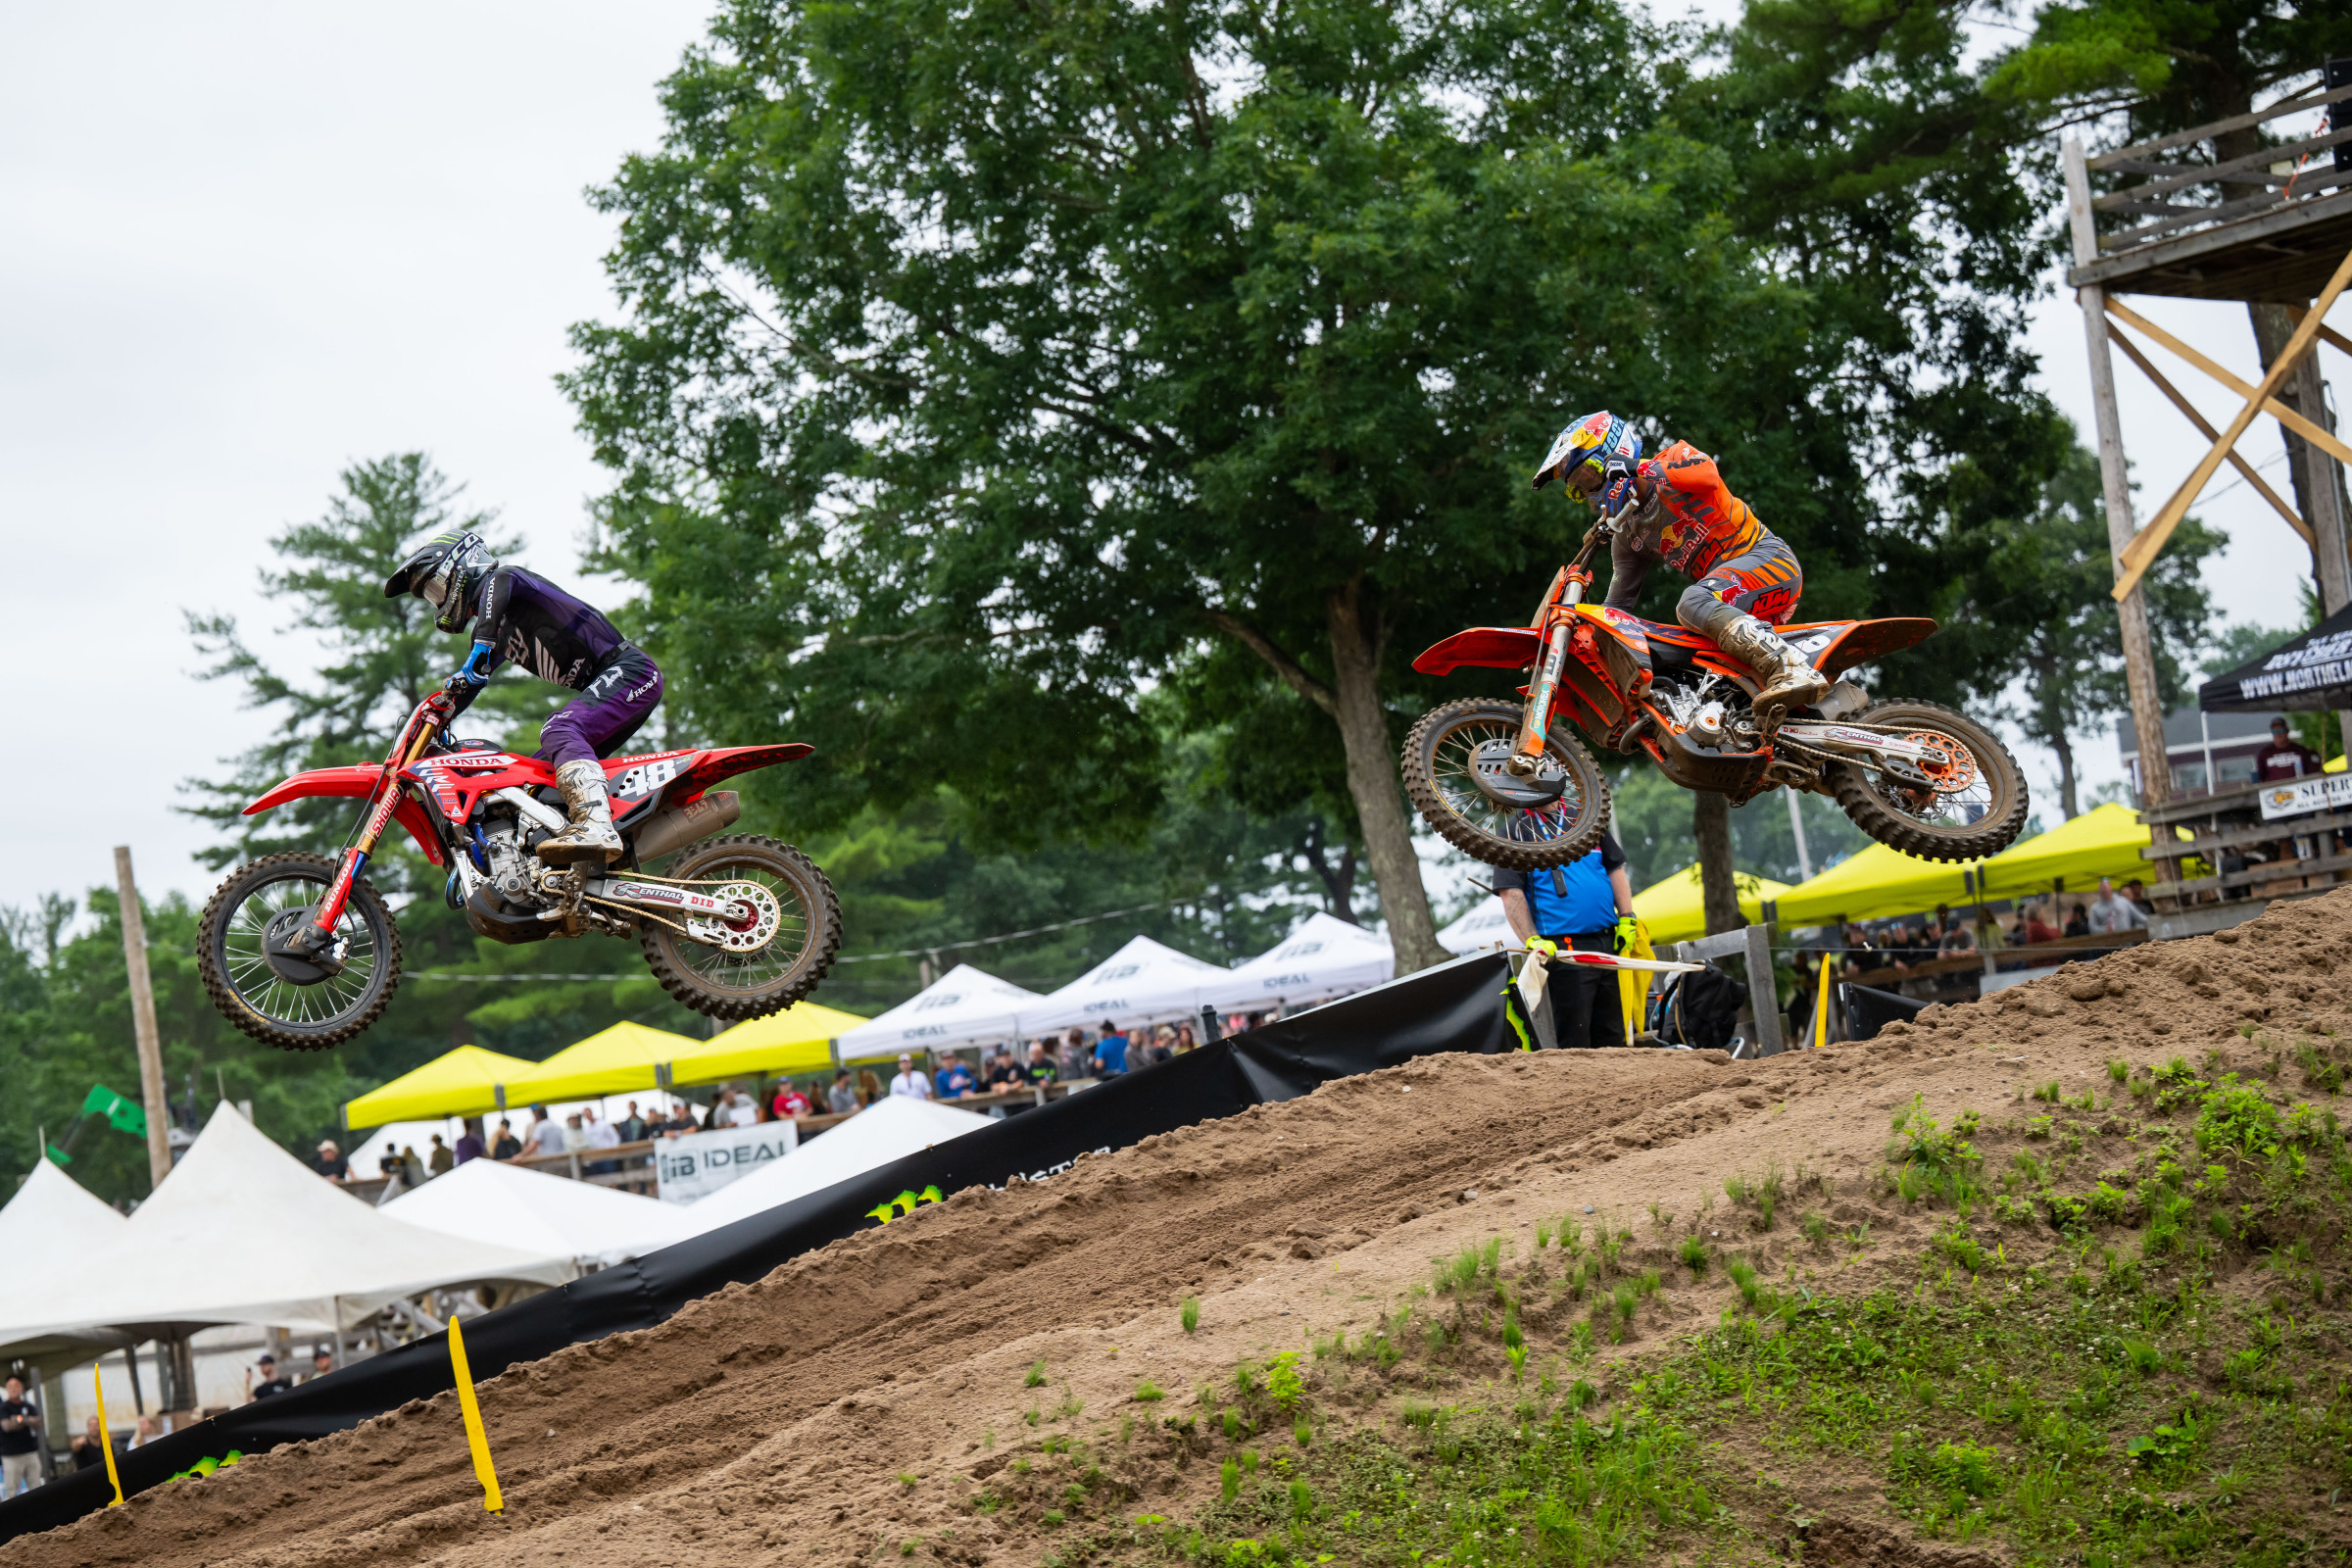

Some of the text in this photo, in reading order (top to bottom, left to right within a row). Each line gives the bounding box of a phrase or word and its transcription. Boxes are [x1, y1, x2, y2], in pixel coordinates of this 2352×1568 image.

[1670, 522, 1709, 571] Red Bull
[485, 576, 496, 619] HONDA
[1750, 587, 1791, 614] KTM
[1535, 690, 1550, 720] MOTOREX
[431, 758, 506, 766] HONDA
[622, 751, 679, 763] HONDA
[619, 760, 677, 797] 48
[371, 787, 400, 838] SHOWA
[323, 858, 353, 912] DUNLOP
[1263, 972, 1311, 990] IDEAL
[1083, 999, 1129, 1013] IDEAL
[903, 1025, 949, 1040] IDEAL
